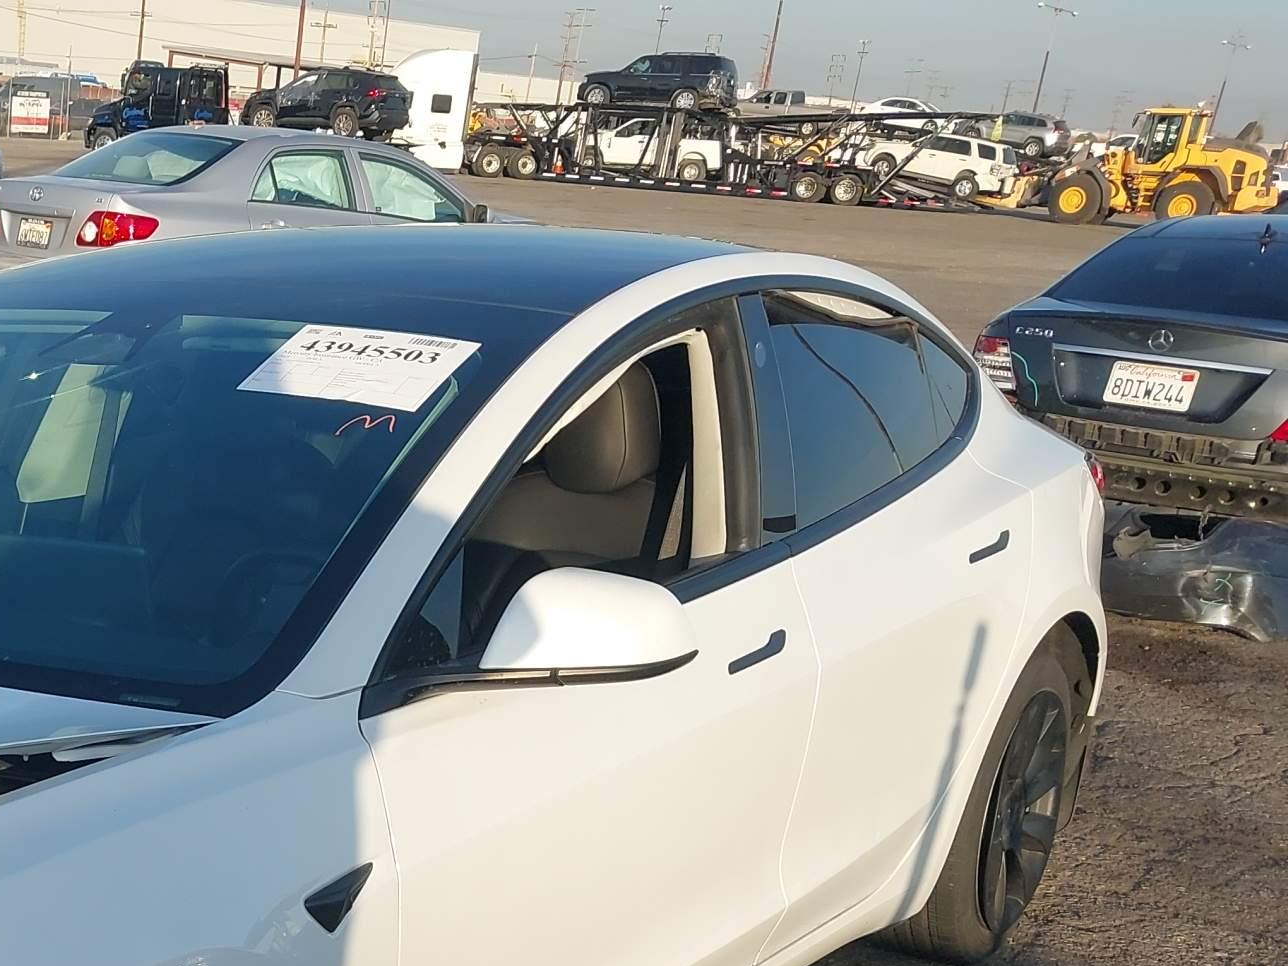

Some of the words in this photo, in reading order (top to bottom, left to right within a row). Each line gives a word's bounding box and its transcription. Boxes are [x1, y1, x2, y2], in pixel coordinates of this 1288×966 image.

[1015, 326, 1054, 338] C250
[300, 339, 441, 365] 43945503
[1130, 364, 1177, 380] California
[1111, 377, 1184, 404] 8DIW244
